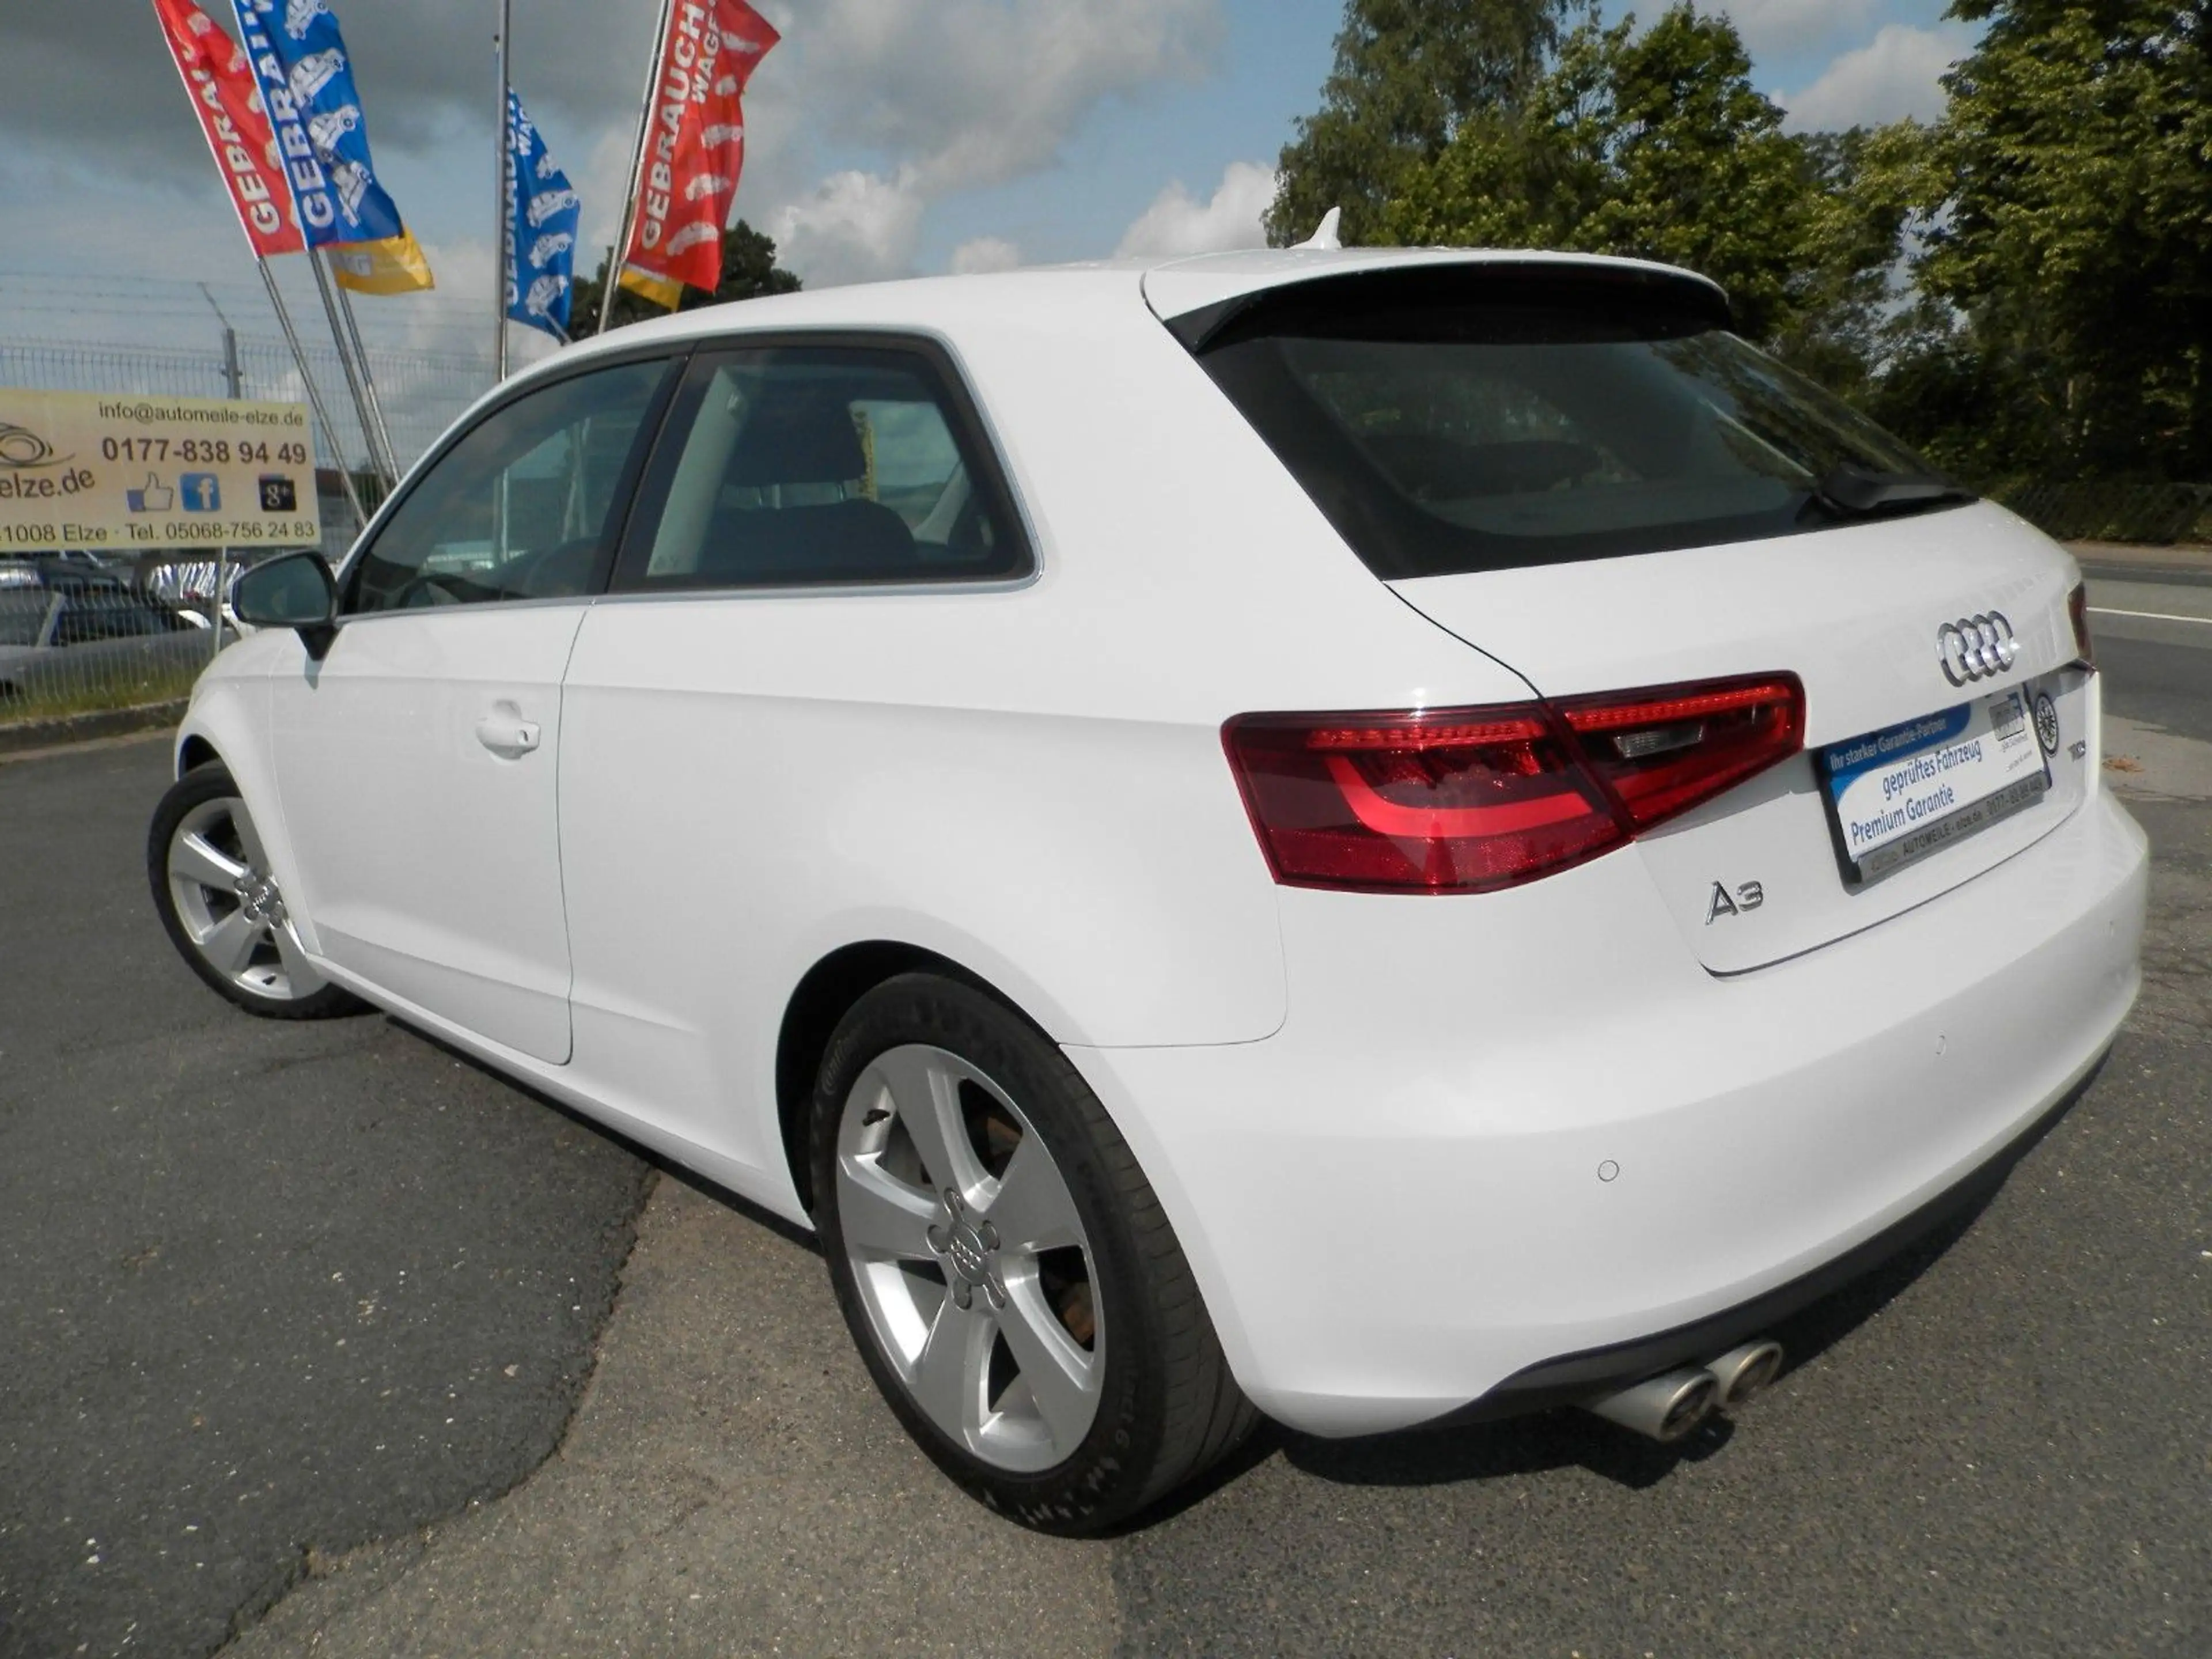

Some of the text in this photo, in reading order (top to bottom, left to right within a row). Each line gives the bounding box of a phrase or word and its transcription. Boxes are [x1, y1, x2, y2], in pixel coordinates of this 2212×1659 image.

[99, 402, 303, 426] info@automeile-elze.de
[102, 436, 306, 465] 0177-838 94 49
[0, 520, 315, 543] 1008 Elze Tel. 05068-756 24 83
[1830, 752, 1844, 772] Ihr
[1846, 741, 1877, 766] starker
[1883, 757, 1936, 801] geprüftes
[1936, 740, 1982, 773] Fahrzeug
[1850, 784, 1955, 846] Premium Garantie
[1705, 880, 1763, 925] A3
